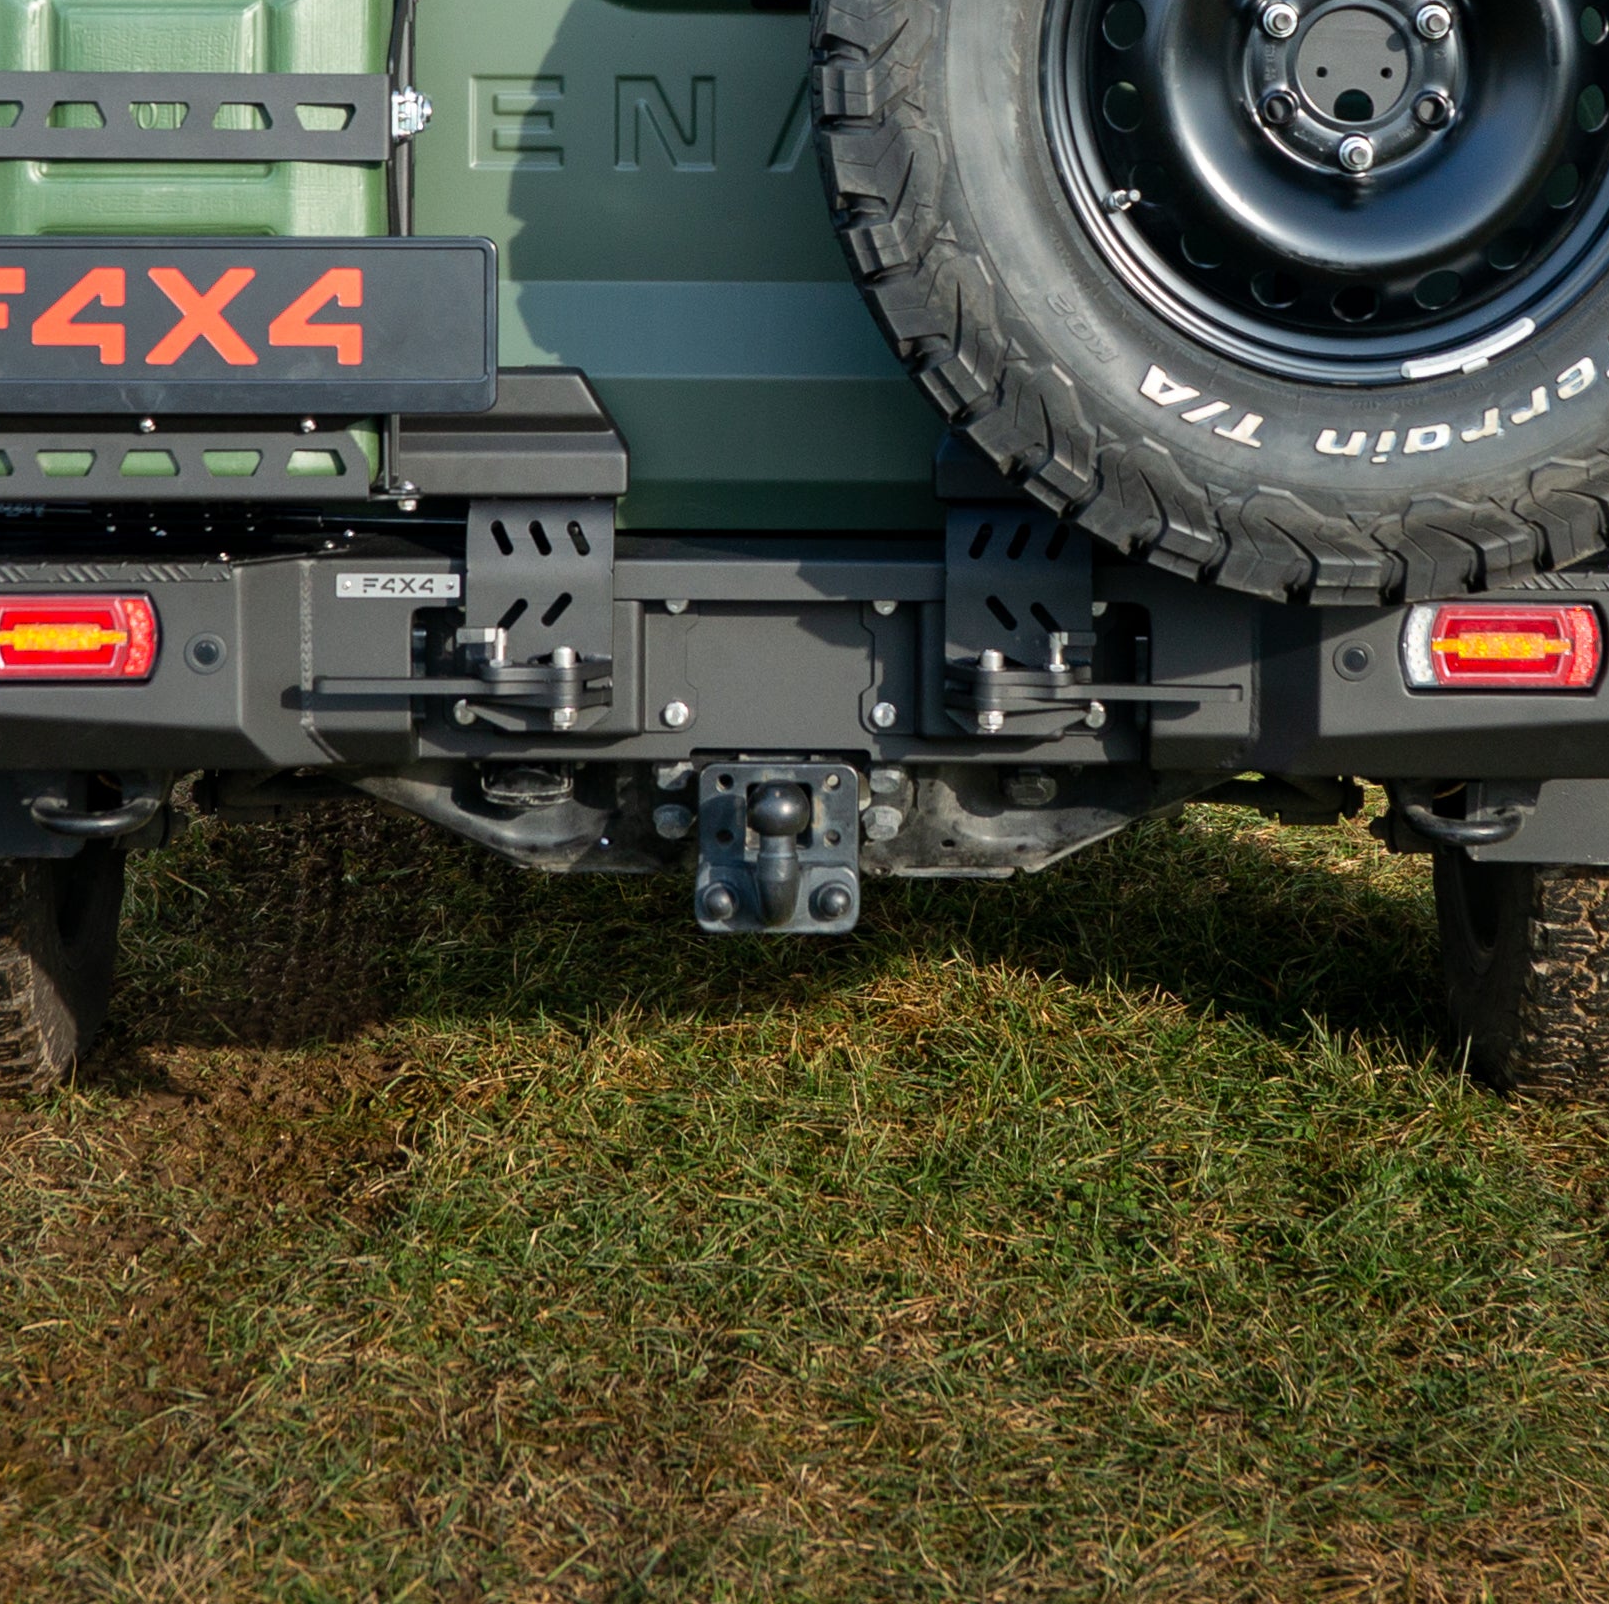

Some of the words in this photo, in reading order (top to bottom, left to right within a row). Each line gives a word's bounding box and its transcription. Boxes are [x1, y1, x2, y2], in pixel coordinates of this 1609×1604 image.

[469, 74, 812, 172] EN
[1136, 365, 1263, 447] T/A
[363, 578, 433, 594] F4X4
